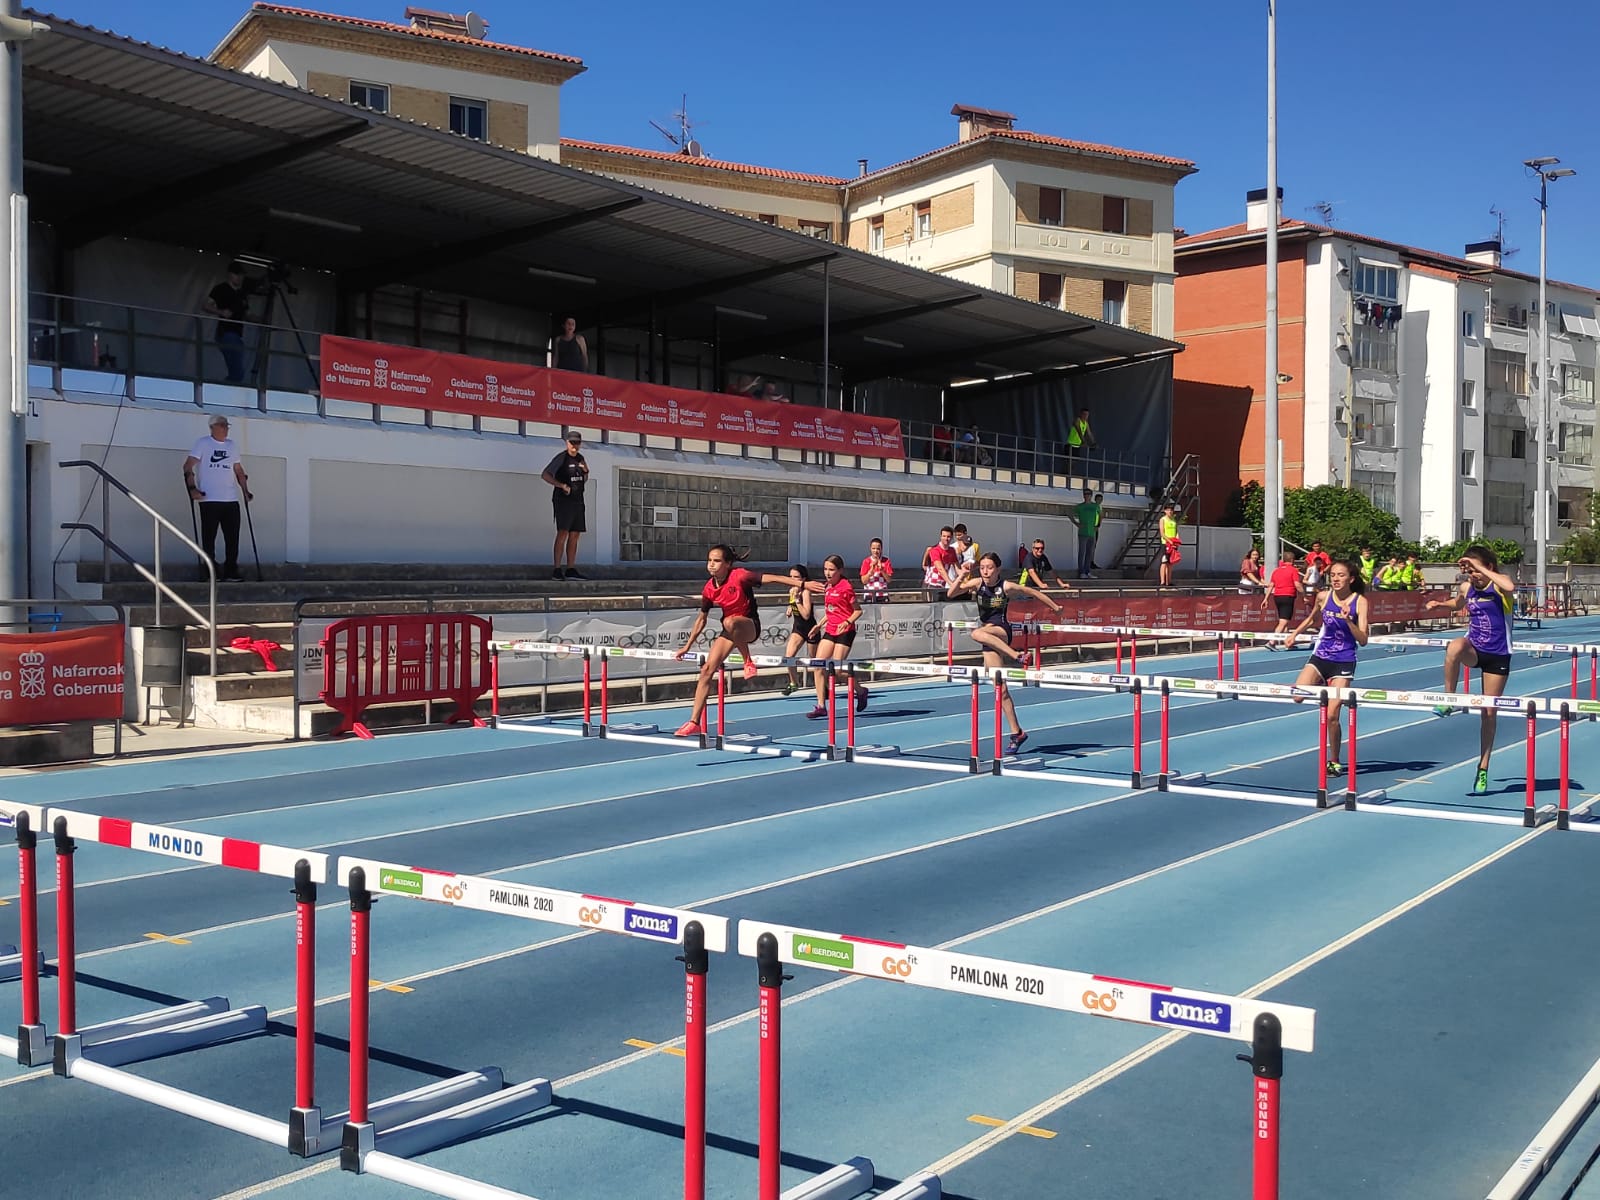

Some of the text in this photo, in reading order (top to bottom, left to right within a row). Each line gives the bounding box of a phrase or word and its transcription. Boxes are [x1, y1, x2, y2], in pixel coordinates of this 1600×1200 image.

[333, 362, 371, 375] Gobierno
[326, 374, 371, 387] de Navarra
[391, 370, 431, 383] Nafarroako
[390, 382, 427, 394] Gobernua
[450, 378, 484, 390] Gobierno
[445, 389, 483, 401] de Navarra
[501, 385, 536, 397] Nafarroako
[500, 396, 532, 407] Gobernua
[579, 636, 594, 645] NKJ
[600, 635, 615, 645] JDN
[658, 632, 671, 640] NKJ
[303, 648, 323, 659] JDN
[52, 663, 124, 678] Nafarroak
[53, 682, 124, 697] Gobernua
[150, 832, 203, 856] MONDO
[442, 883, 463, 900] GO
[489, 889, 553, 912] PAMLONA 2020
[578, 904, 607, 925] GO fit
[811, 947, 850, 961] IBERDROLA
[881, 954, 918, 977] GO fit
[950, 965, 1044, 995] PAMLONA 2020
[1081, 987, 1124, 1012] GO fit
[1258, 1091, 1268, 1139] MONDO
